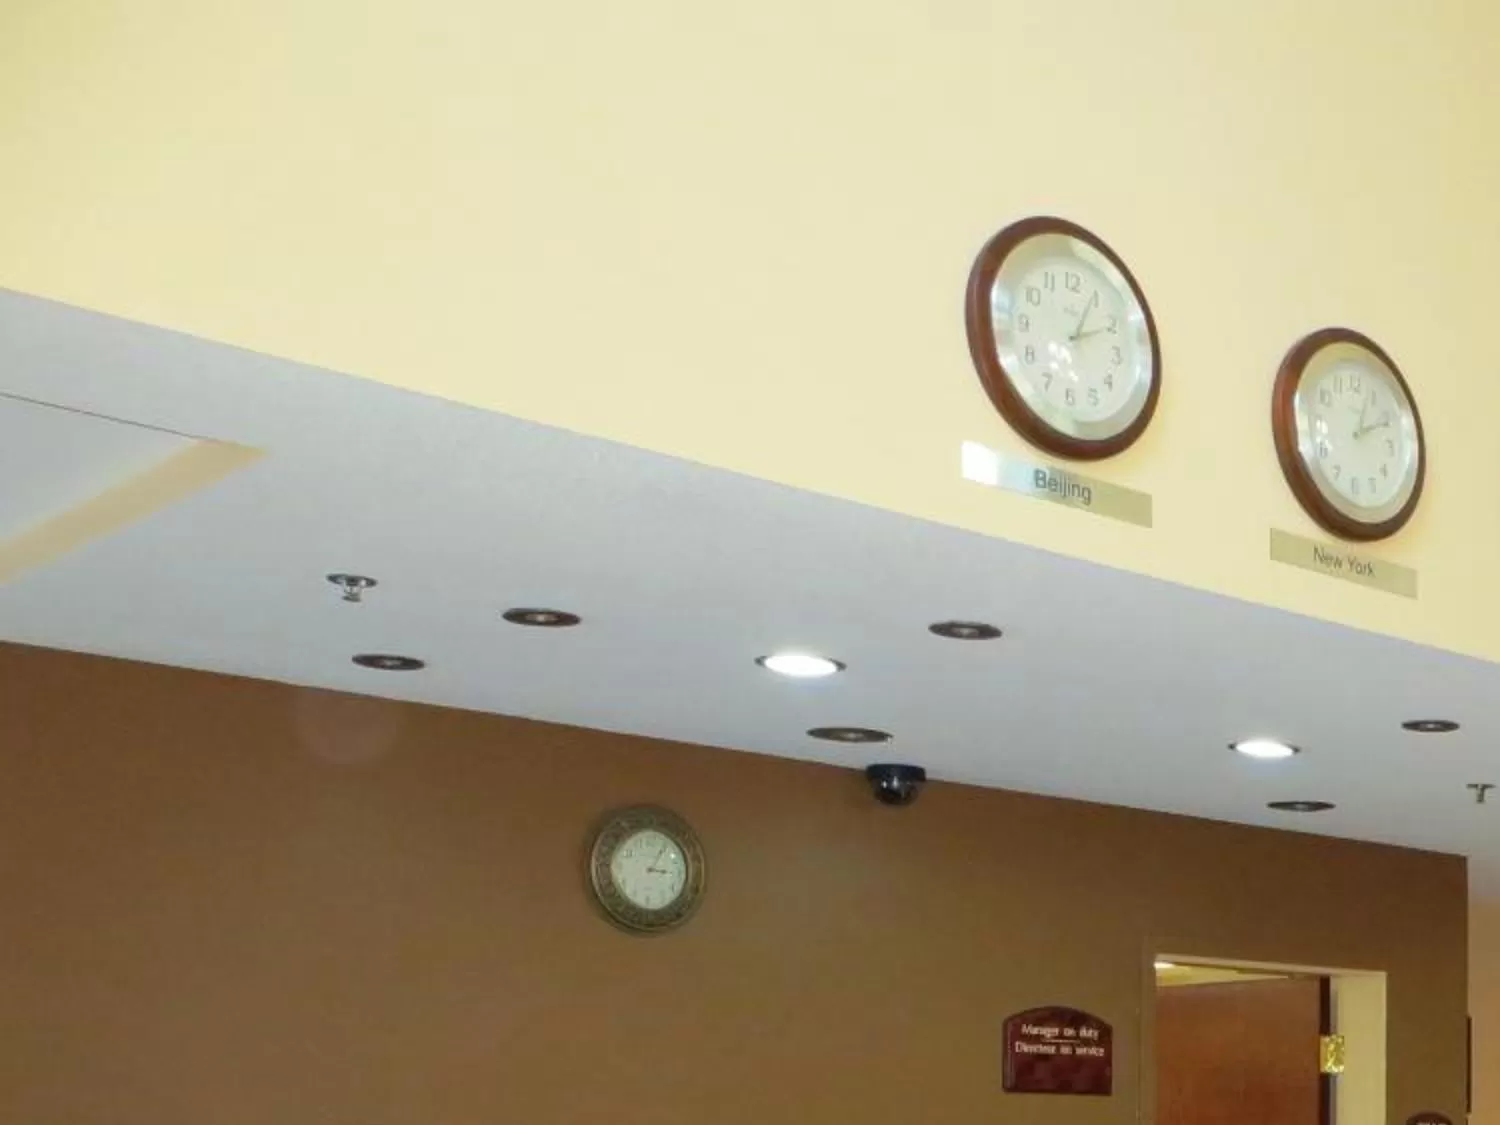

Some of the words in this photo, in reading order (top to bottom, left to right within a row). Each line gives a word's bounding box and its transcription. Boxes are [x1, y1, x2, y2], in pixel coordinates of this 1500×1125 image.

[1044, 271, 1055, 293] 11
[1065, 271, 1081, 294] 12
[1026, 286, 1042, 307] 10
[1018, 313, 1030, 333] 9
[1107, 315, 1118, 335] 2
[1025, 345, 1035, 365] 8
[1111, 345, 1122, 366] 3
[1042, 371, 1054, 392] 7
[1103, 371, 1113, 392] 4
[1065, 387, 1075, 407] 6
[1034, 468, 1092, 507] Beijing
[1313, 545, 1343, 570] New
[1347, 554, 1377, 579] York
[1021, 1023, 1060, 1039] Manager
[1063, 1027, 1077, 1037] on
[1079, 1025, 1099, 1041] duty
